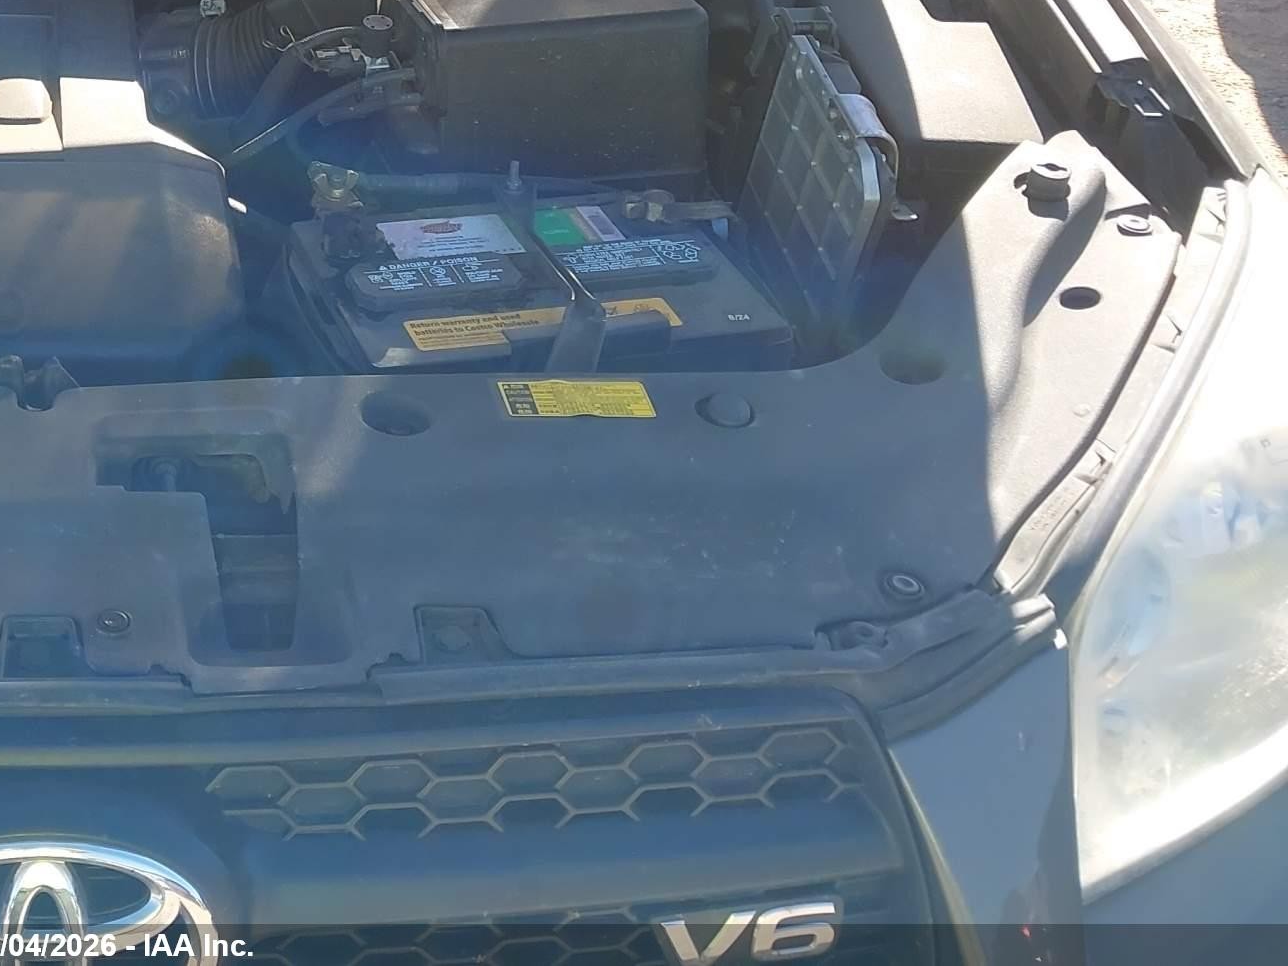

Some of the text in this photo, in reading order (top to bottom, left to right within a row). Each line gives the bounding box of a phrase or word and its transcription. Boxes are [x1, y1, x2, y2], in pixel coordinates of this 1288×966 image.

[389, 260, 430, 270] DANGER
[439, 256, 478, 265] POISON
[441, 317, 481, 326] warranty
[414, 328, 452, 336] batteries
[465, 323, 492, 331] Costco
[661, 902, 836, 964] V6
